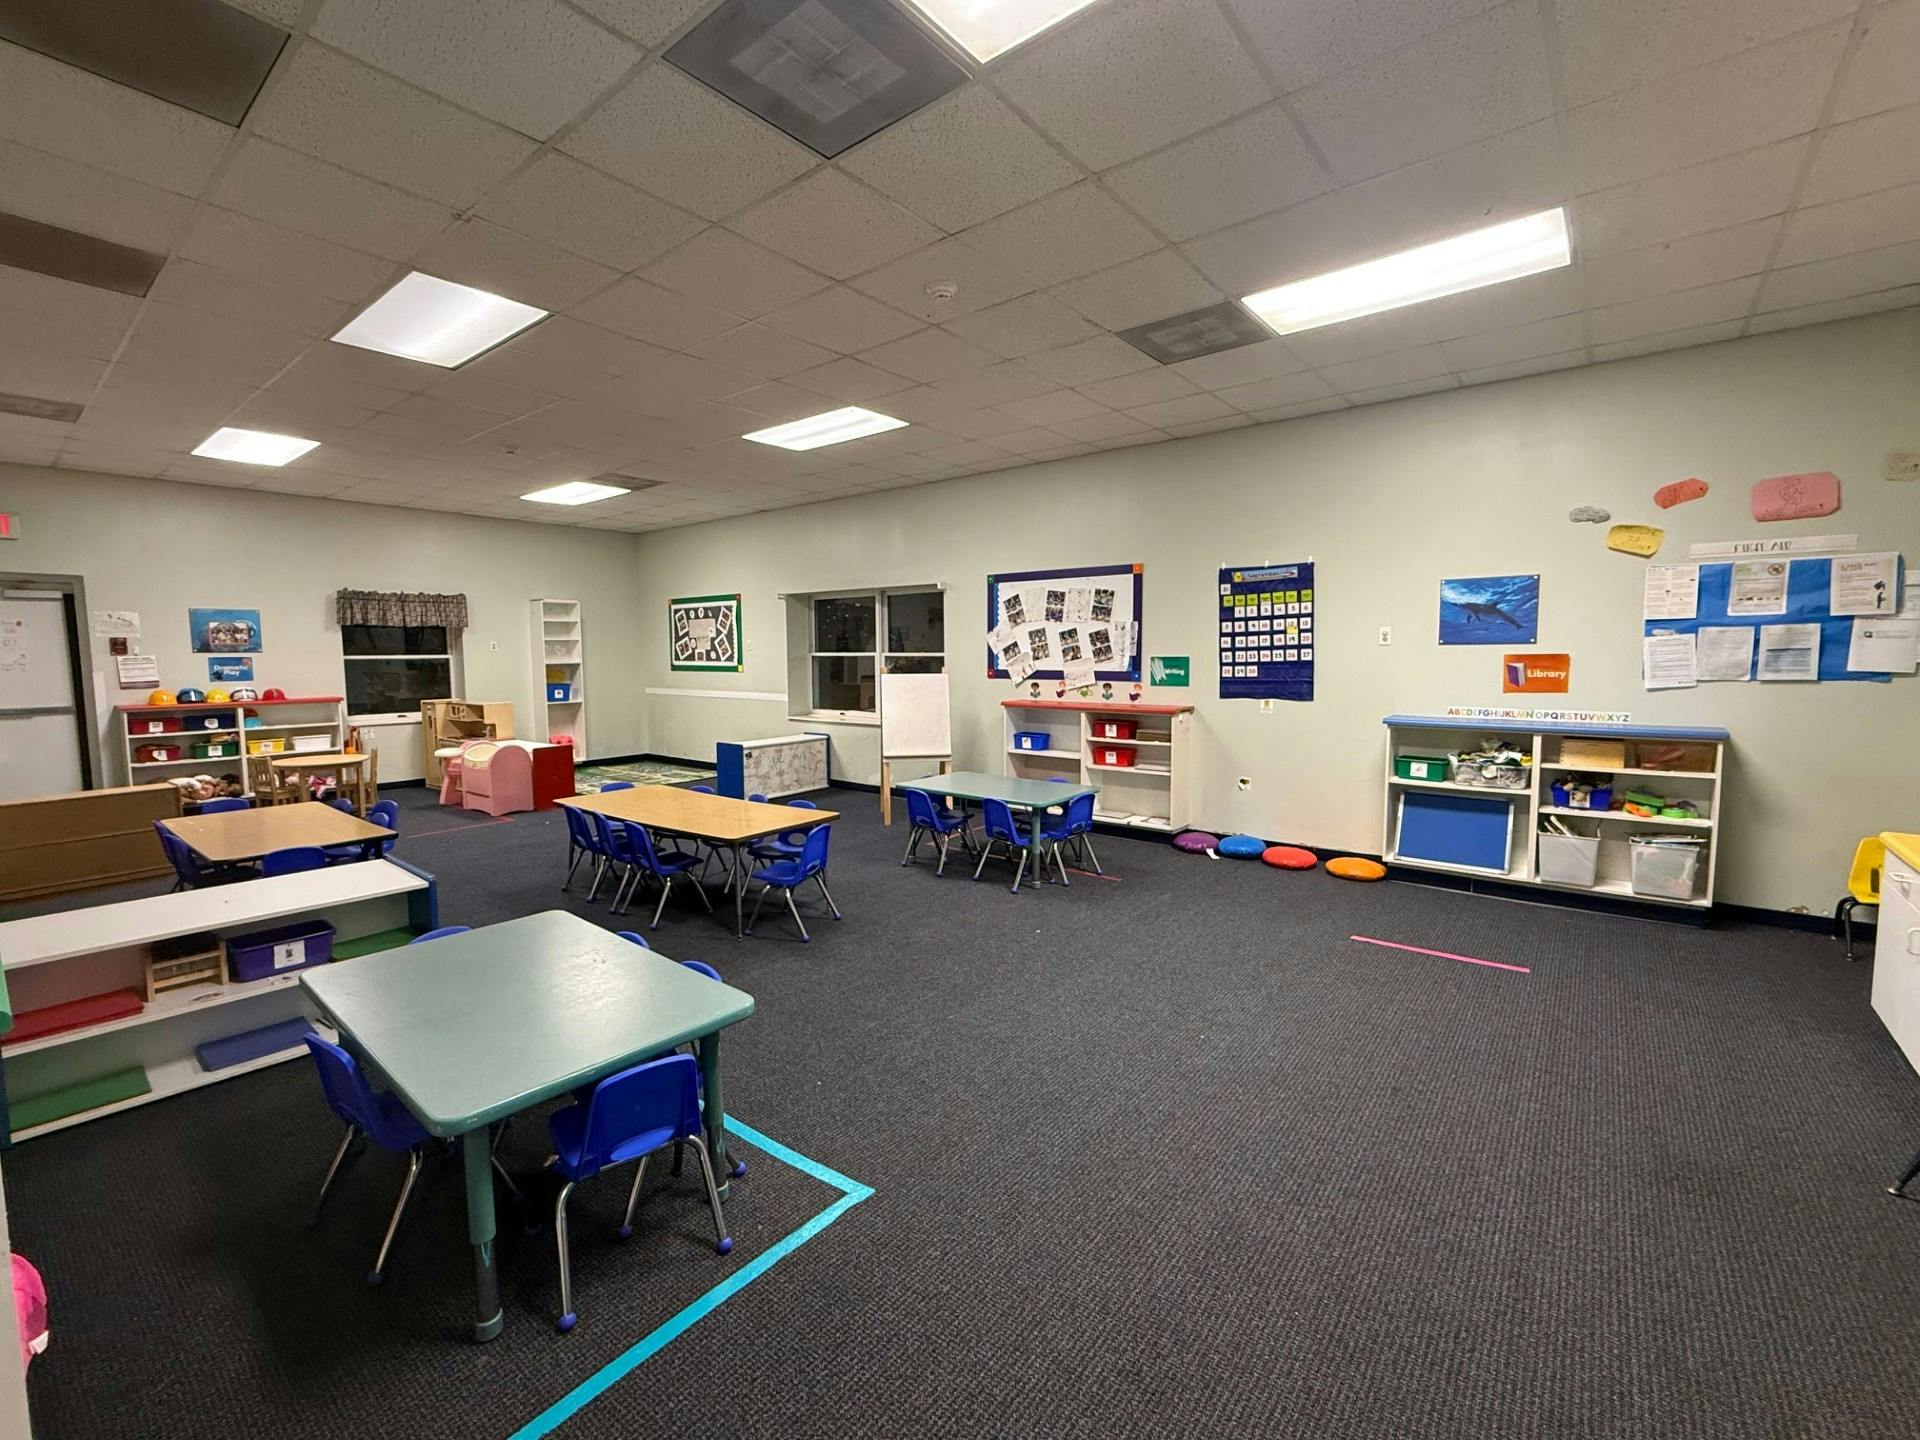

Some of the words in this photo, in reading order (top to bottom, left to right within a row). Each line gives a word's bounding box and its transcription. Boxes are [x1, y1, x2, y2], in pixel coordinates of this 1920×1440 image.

[1247, 571, 1280, 579] September
[1164, 668, 1185, 676] Writing
[1527, 669, 1567, 680] Library
